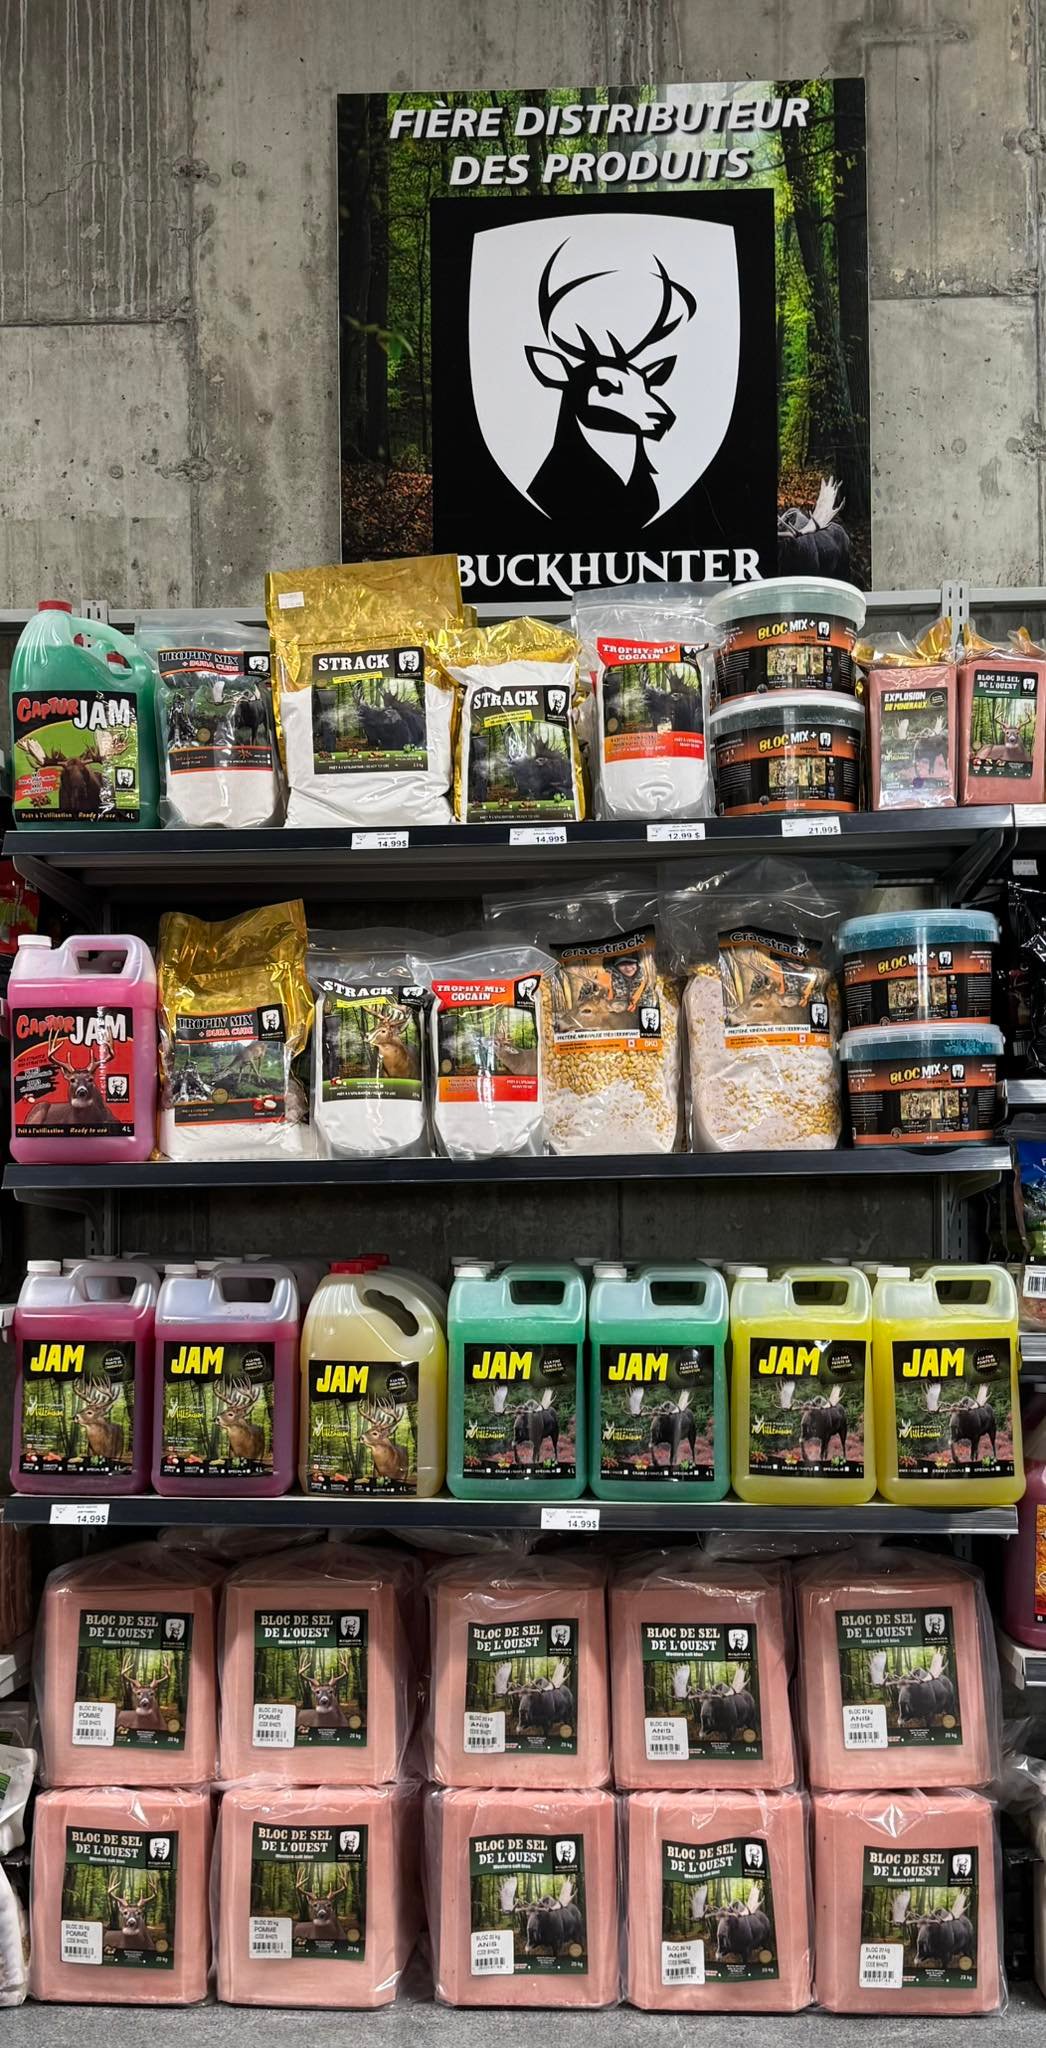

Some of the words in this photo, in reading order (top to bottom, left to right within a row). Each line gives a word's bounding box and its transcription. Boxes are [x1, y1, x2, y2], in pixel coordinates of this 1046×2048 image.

[390, 101, 503, 138] FIÈRE
[514, 98, 809, 136] DISTRIBUTEUR
[450, 154, 530, 185] DES
[543, 148, 751, 183] PRODUITS
[459, 548, 763, 596] BUCKHUNTER
[757, 622, 788, 640] BLOC
[789, 619, 808, 632] MIX
[160, 651, 211, 661] TROPHY
[214, 654, 238, 665] MIX
[318, 654, 390, 671] STRACK
[977, 674, 995, 682] BLOC
[1007, 675, 1020, 683] SEL
[979, 681, 988, 689] DE
[990, 682, 1017, 690] L'OUEST
[473, 689, 539, 710] STRACK
[884, 691, 926, 702] EXPLOSION
[73, 698, 130, 732] JAM
[759, 734, 789, 753] BLOC
[790, 730, 809, 744] MIX
[377, 840, 407, 848] 14.99$
[877, 956, 907, 974] BLOC
[908, 952, 927, 965] MIX
[323, 980, 393, 997] STRACK
[451, 992, 491, 1001] COCAIN
[177, 1016, 228, 1029] TROPHY
[230, 1014, 253, 1026] MIX
[69, 1013, 126, 1047] JAM
[890, 1068, 921, 1084] BLOC
[921, 1064, 940, 1078] MIX
[69, 1127, 88, 1135] Ready
[30, 1344, 85, 1372] JAM
[171, 1346, 224, 1374] JAM
[472, 1351, 533, 1380] JAM
[758, 1346, 821, 1376] JAM
[902, 1347, 965, 1377] JAM
[608, 1352, 669, 1381] JAM
[316, 1365, 369, 1393] JAM
[76, 1515, 106, 1523] 14.99$
[567, 1520, 597, 1528] 14.99$
[86, 1614, 117, 1625] BLOC
[118, 1615, 135, 1626] DE
[137, 1616, 159, 1627] SEL
[260, 1615, 291, 1625] BLOC
[293, 1615, 309, 1625] DE
[311, 1615, 334, 1625] SEL
[841, 1615, 873, 1626] BLOC
[875, 1614, 891, 1625] DE
[893, 1613, 916, 1624] SEL
[89, 1626, 104, 1637] DE
[107, 1627, 155, 1640] L'OUEST
[264, 1627, 280, 1638] DE
[282, 1627, 330, 1638] L'OUEST
[473, 1626, 503, 1640] BLOC
[504, 1626, 521, 1638] DE
[522, 1624, 543, 1636] SEL
[646, 1627, 677, 1638] BLOC
[679, 1628, 696, 1638] DE
[697, 1628, 721, 1638] SEL
[846, 1627, 862, 1638] DE
[864, 1626, 913, 1637] L'OUEST
[476, 1640, 491, 1652] DE
[493, 1637, 539, 1650] L'OUEST
[651, 1640, 667, 1650] DE
[669, 1640, 717, 1651] L'OUEST
[71, 1831, 101, 1843] BLOC
[103, 1833, 118, 1844] DE
[121, 1835, 143, 1847] SEL
[258, 1827, 288, 1839] BLOC
[291, 1829, 307, 1840] DE
[310, 1830, 333, 1841] SEL
[75, 1843, 91, 1854] DE
[93, 1844, 139, 1859] L'OUEST
[261, 1840, 277, 1851] DE
[279, 1841, 328, 1853] L'OUEST
[474, 1840, 504, 1853] BLOC
[507, 1839, 523, 1851] DE
[525, 1840, 547, 1851] SEL
[667, 1845, 696, 1860] BLOC
[699, 1848, 714, 1860] DE
[716, 1843, 737, 1856] SEL
[479, 1853, 494, 1865] DE
[497, 1852, 544, 1863] L'OUEST
[671, 1860, 686, 1872] DE
[688, 1856, 734, 1873] L'OUEST
[869, 1852, 901, 1864] BLOC
[903, 1853, 920, 1864] DE
[922, 1853, 945, 1864] SEL
[872, 1865, 888, 1876] DE
[891, 1865, 940, 1877] L'OUEST
